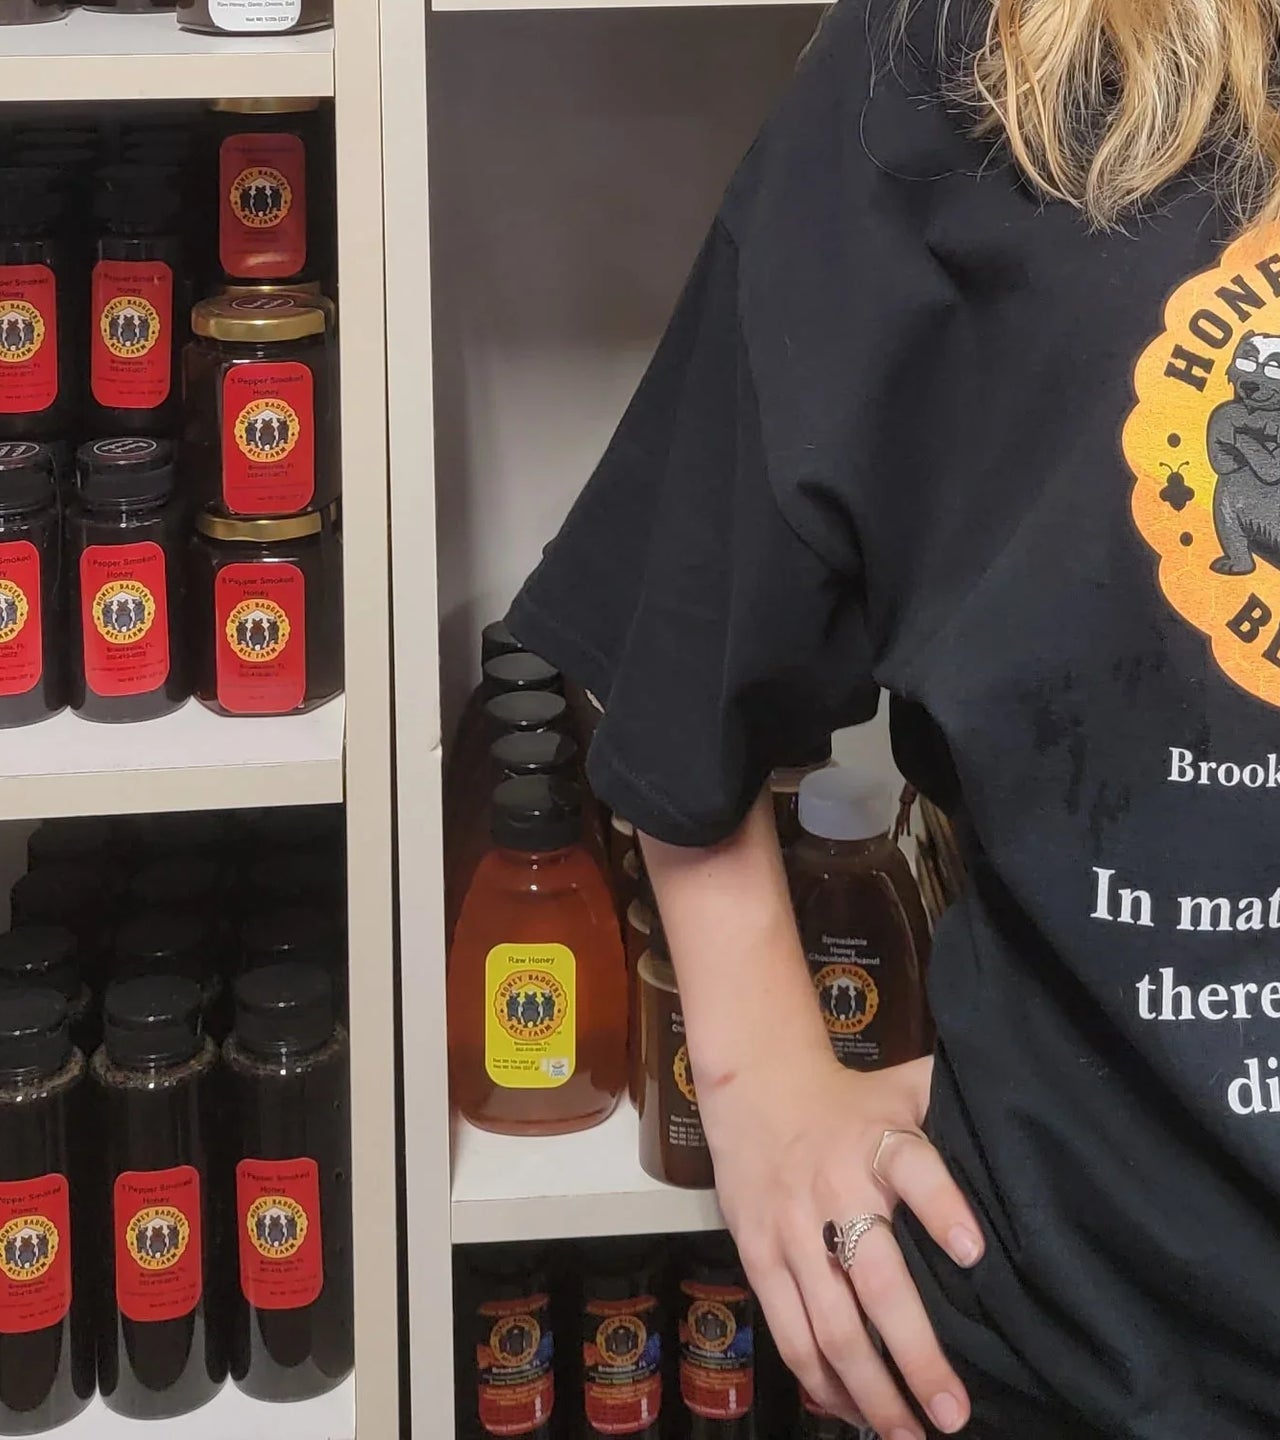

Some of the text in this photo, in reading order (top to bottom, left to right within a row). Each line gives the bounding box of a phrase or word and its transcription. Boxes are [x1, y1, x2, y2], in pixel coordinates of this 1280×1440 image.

[1090, 866, 1152, 927] In
[508, 956, 554, 965] Raw Honey
